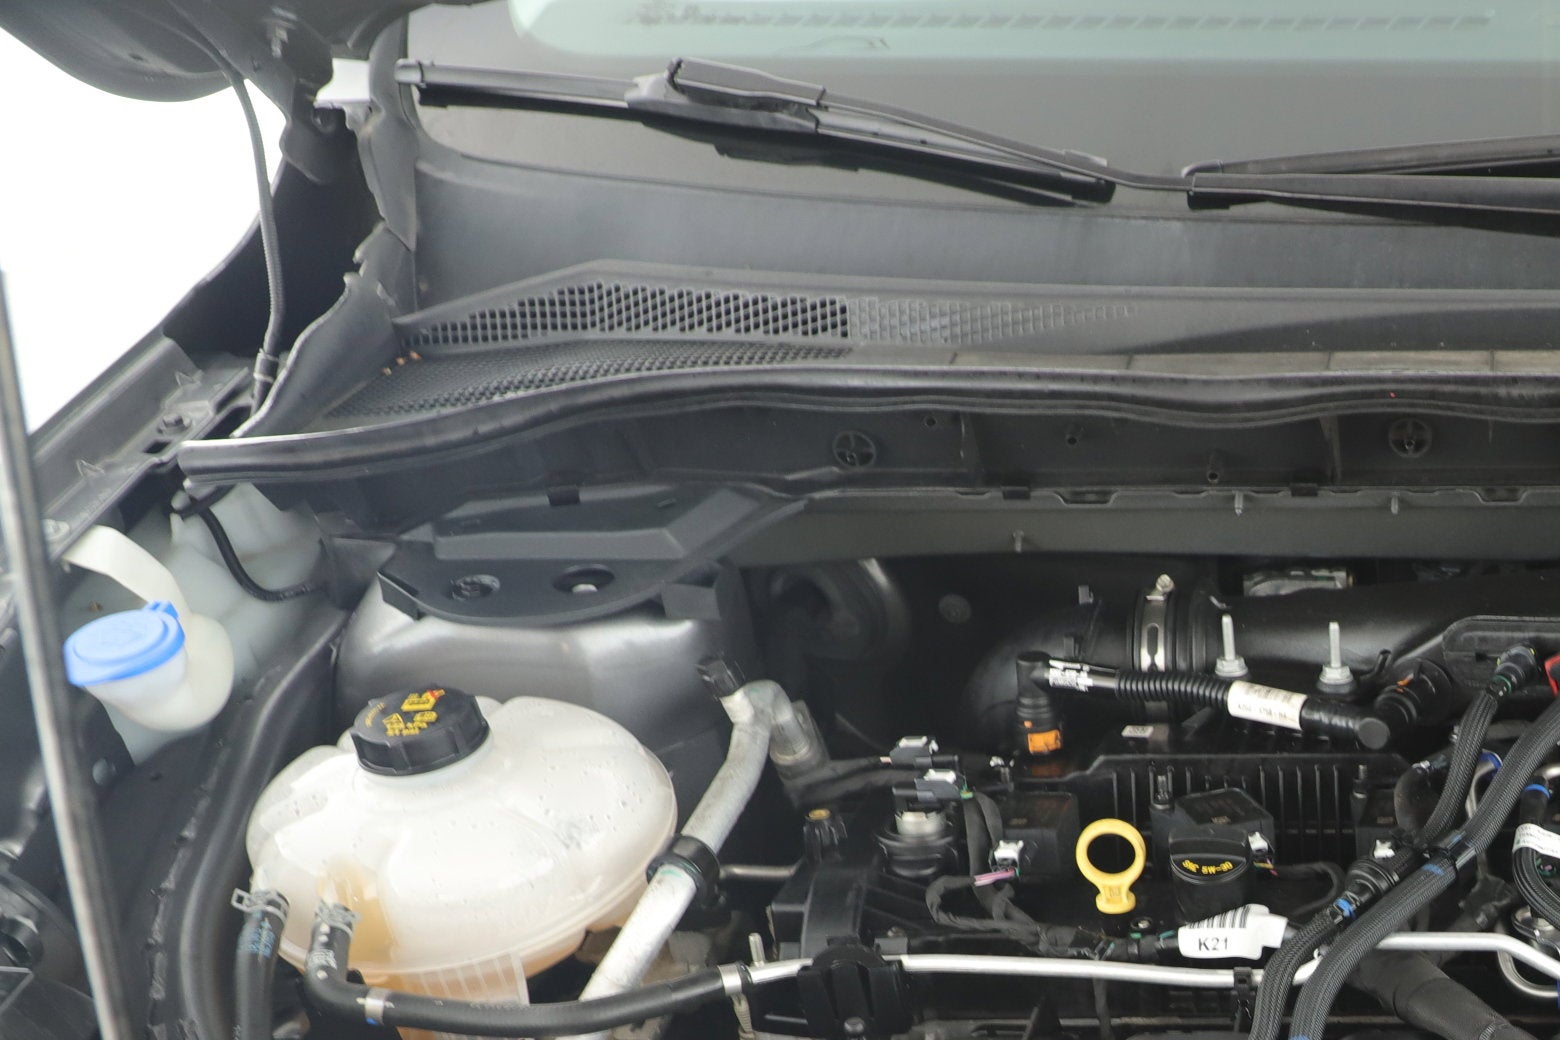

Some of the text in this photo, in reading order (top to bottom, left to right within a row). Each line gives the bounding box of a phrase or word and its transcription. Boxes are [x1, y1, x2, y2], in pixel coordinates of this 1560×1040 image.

[1182, 860, 1233, 875] SAE 5W-30
[1198, 937, 1228, 952] K21
